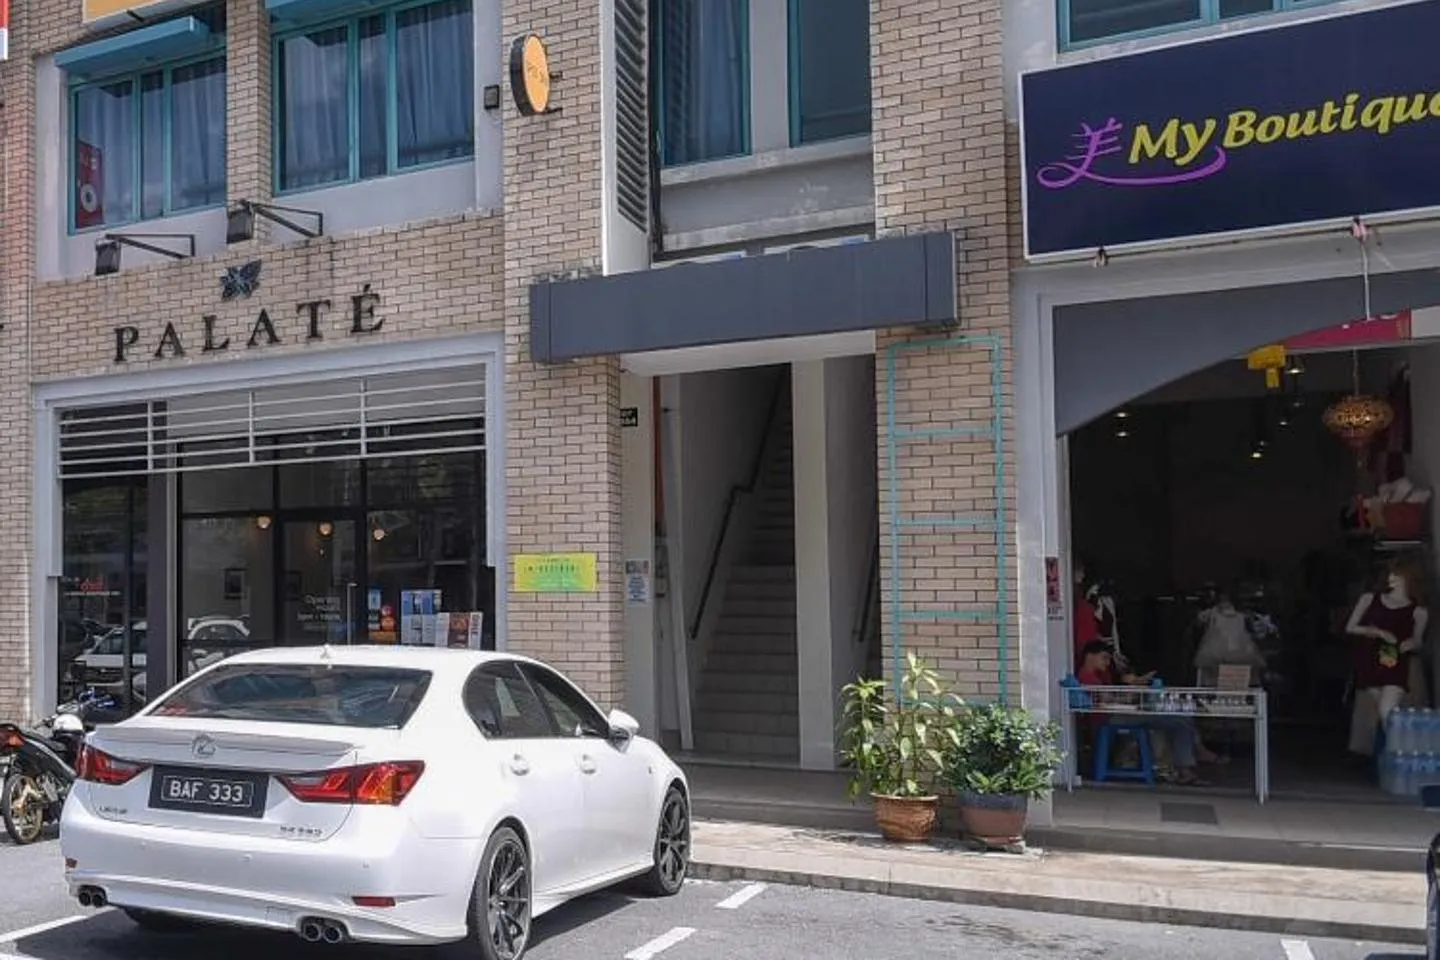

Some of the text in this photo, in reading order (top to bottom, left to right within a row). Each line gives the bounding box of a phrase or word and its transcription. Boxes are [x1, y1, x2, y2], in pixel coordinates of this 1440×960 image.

[1129, 118, 1217, 166] My
[114, 284, 386, 362] PALATÉ
[169, 780, 243, 803] BAF 333
